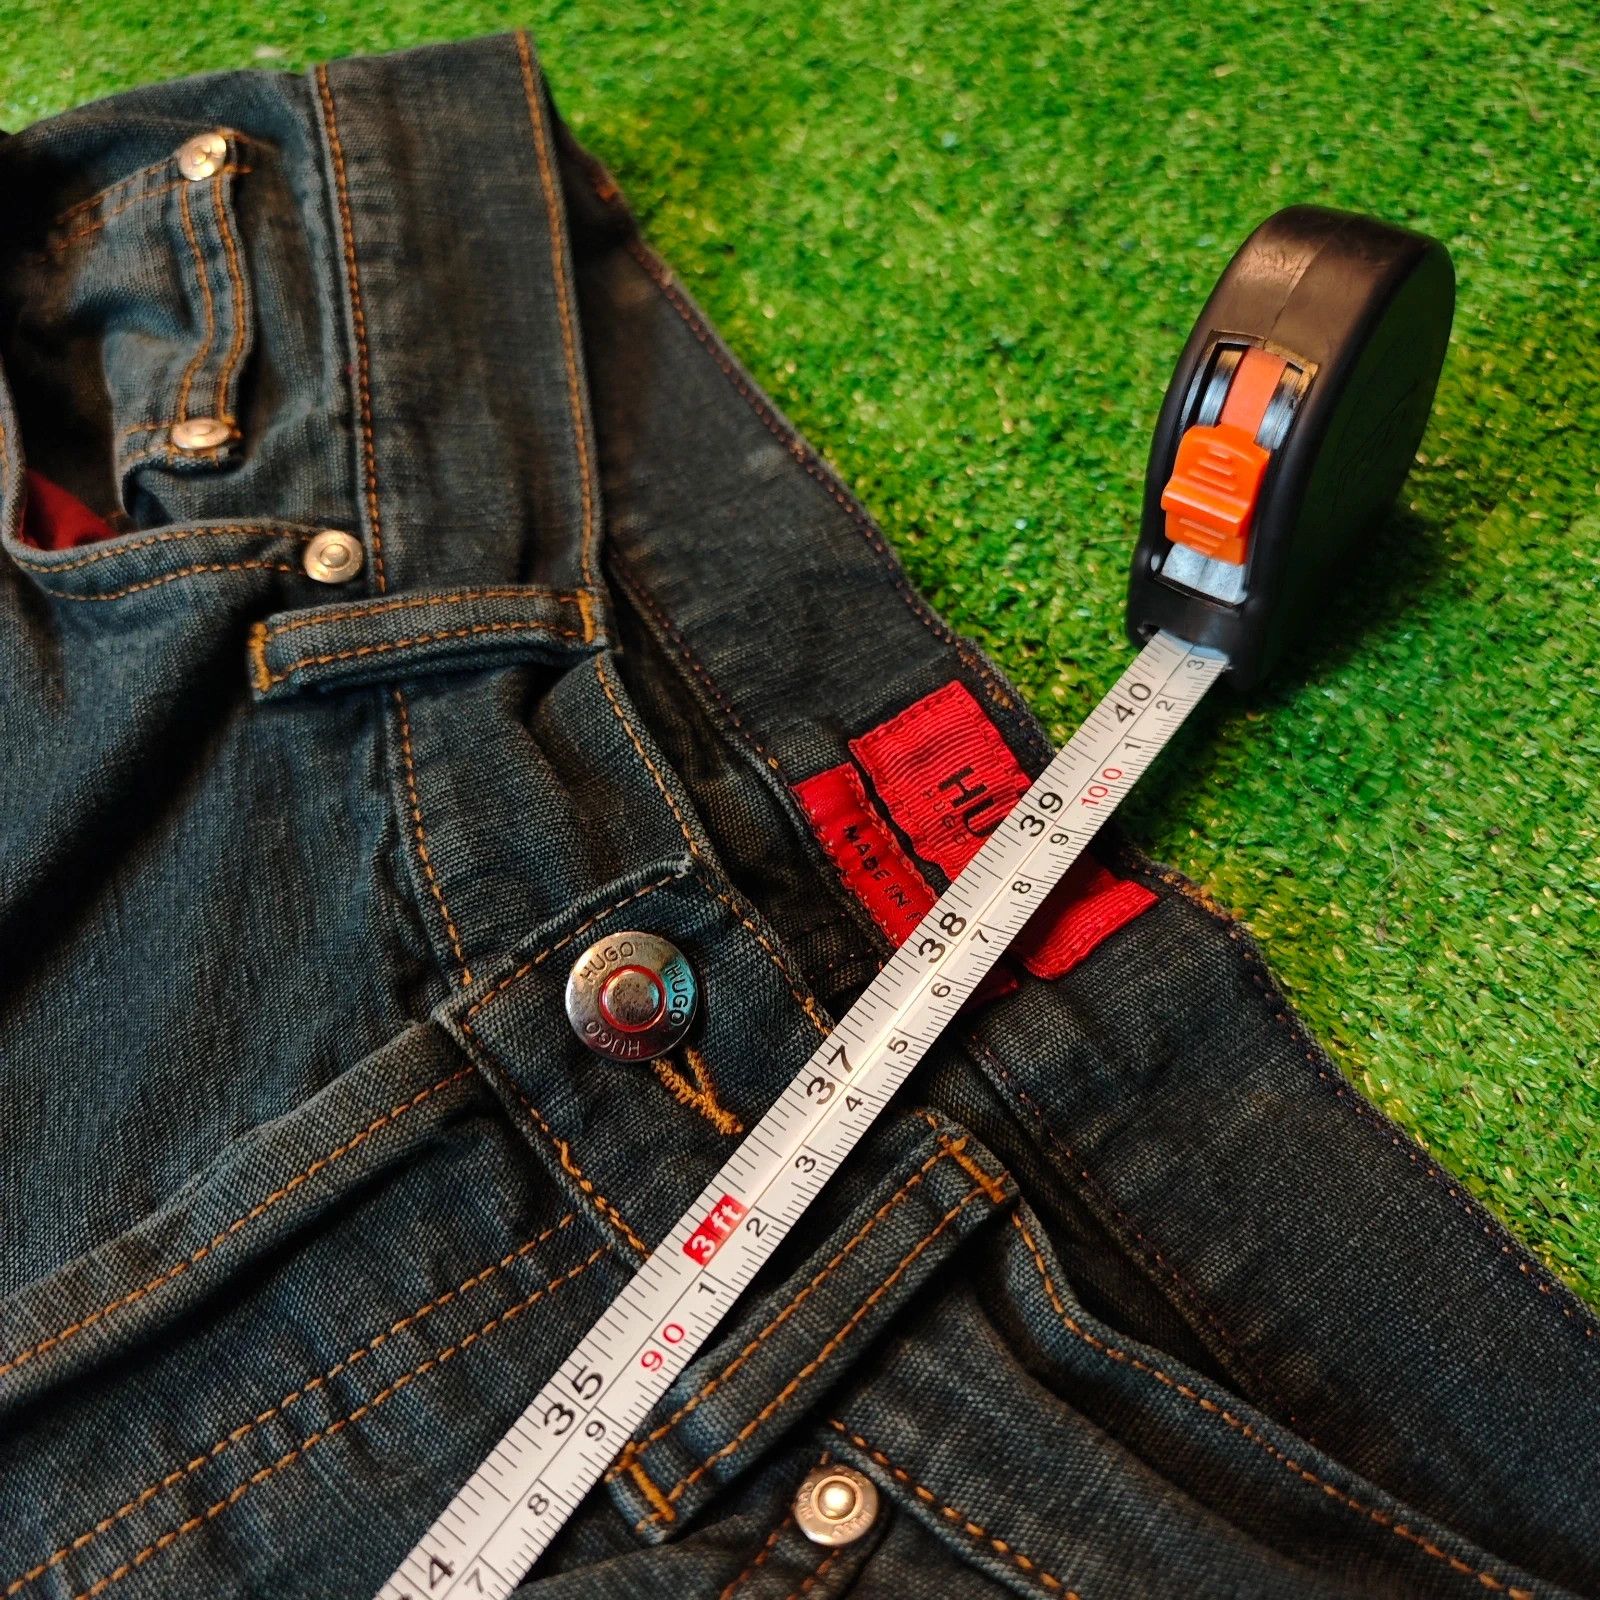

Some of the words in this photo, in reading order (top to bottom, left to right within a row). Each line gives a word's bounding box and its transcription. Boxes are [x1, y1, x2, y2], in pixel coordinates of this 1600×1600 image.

[1187, 659, 1205, 670] 3
[1115, 683, 1152, 723] 40
[1155, 700, 1176, 712] 2
[1124, 742, 1142, 750] 1
[1081, 767, 1122, 807] 100
[1019, 791, 1063, 837] 39
[1050, 832, 1070, 846] 9
[844, 825, 894, 881] MADE
[883, 882, 914, 909] IN
[1012, 880, 1032, 894] 8
[918, 911, 967, 964] 38
[970, 929, 990, 944] 7
[579, 941, 636, 986] HUGO
[665, 963, 689, 1027] HUGO
[931, 982, 951, 998] 6
[887, 1036, 908, 1055] 5
[806, 1045, 853, 1105] 37
[845, 1094, 863, 1112] 4
[795, 1155, 816, 1174] 3
[691, 1234, 717, 1259] 3
[711, 1203, 743, 1232] ft
[746, 1217, 769, 1238] 2
[698, 1282, 717, 1296] 1
[640, 1322, 685, 1372] 90
[543, 1365, 604, 1436] 35
[585, 1420, 607, 1442] 9
[527, 1492, 550, 1517] 8
[464, 1567, 484, 1593] 7
